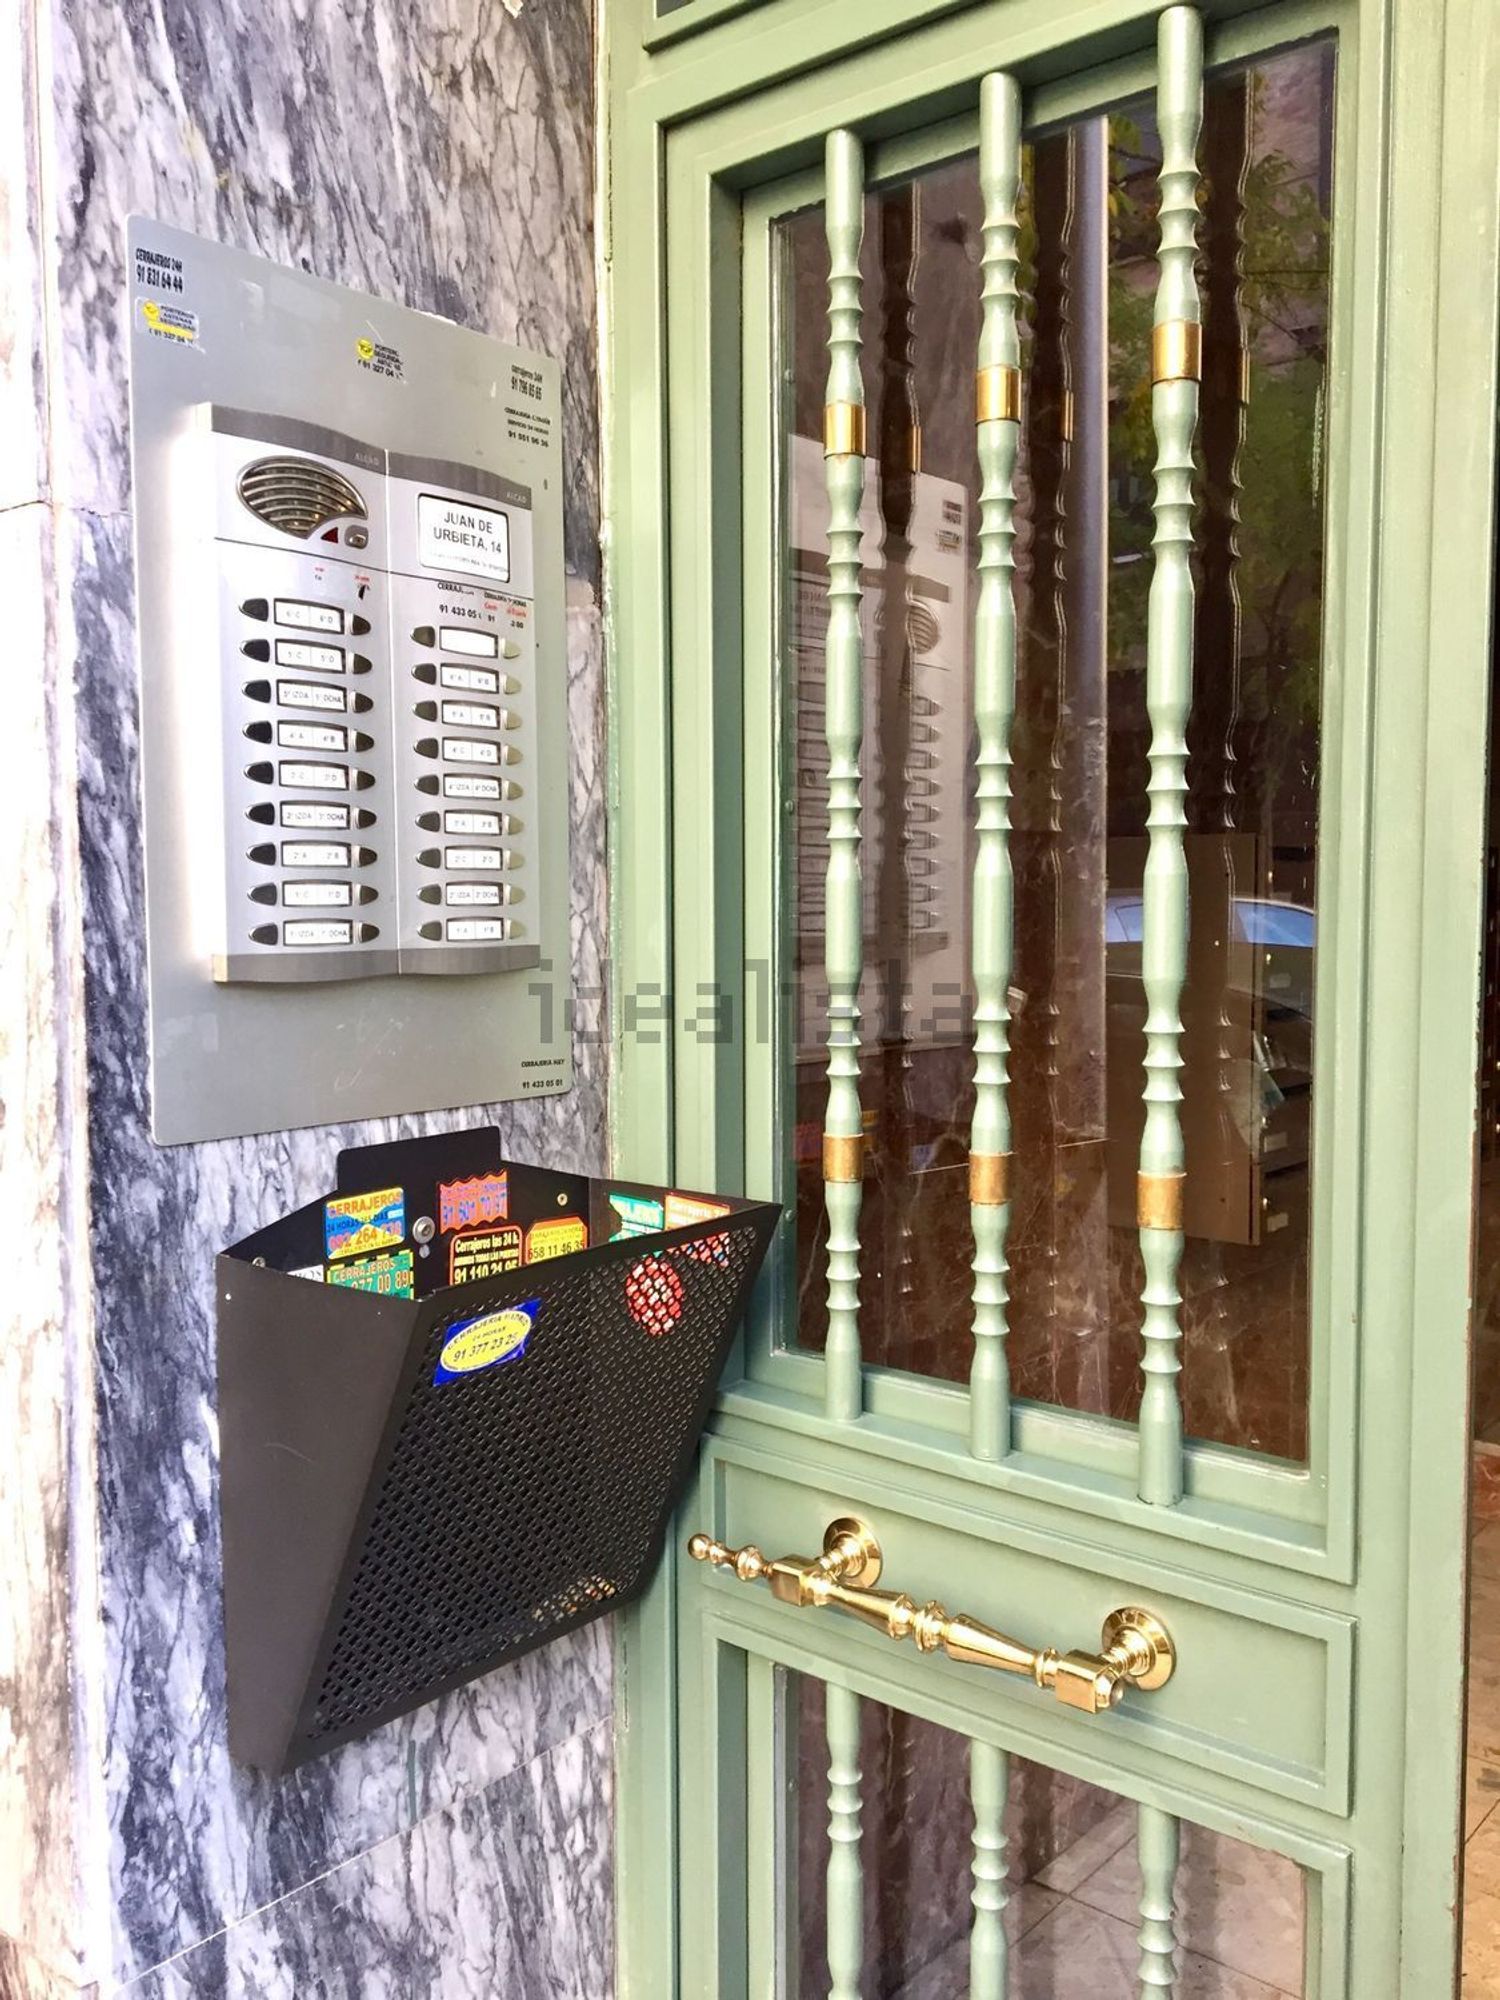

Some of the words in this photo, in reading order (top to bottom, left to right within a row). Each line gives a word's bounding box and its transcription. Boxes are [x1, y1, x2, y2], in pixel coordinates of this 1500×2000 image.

[136, 264, 145, 283] 91
[173, 275, 183, 293] 44
[508, 430, 516, 438] 91
[443, 511, 475, 529] JUAN
[478, 519, 493, 535] DE
[433, 527, 488, 552] URBIETA,
[491, 540, 502, 553] 14
[439, 604, 448, 613] 91
[451, 606, 466, 617] 433
[467, 609, 477, 619] 05
[532, 1080, 544, 1088] 433
[546, 1079, 554, 1087] 05
[328, 1191, 401, 1218] CERRAJEROS
[354, 1227, 377, 1245] 264
[454, 1236, 490, 1253] Cerrajeros
[492, 1234, 502, 1249] las
[503, 1231, 512, 1247] 24
[528, 1246, 544, 1260] 658
[548, 1244, 557, 1256] 11
[334, 1259, 396, 1281] CERRAJEROS
[377, 1273, 391, 1293] 00
[395, 1269, 410, 1289] 89
[454, 1267, 466, 1285] 91
[448, 1315, 502, 1350] CERRAJERIA
[453, 1348, 467, 1362] 91
[469, 1341, 489, 1357] 377
[491, 1337, 504, 1350] 23
